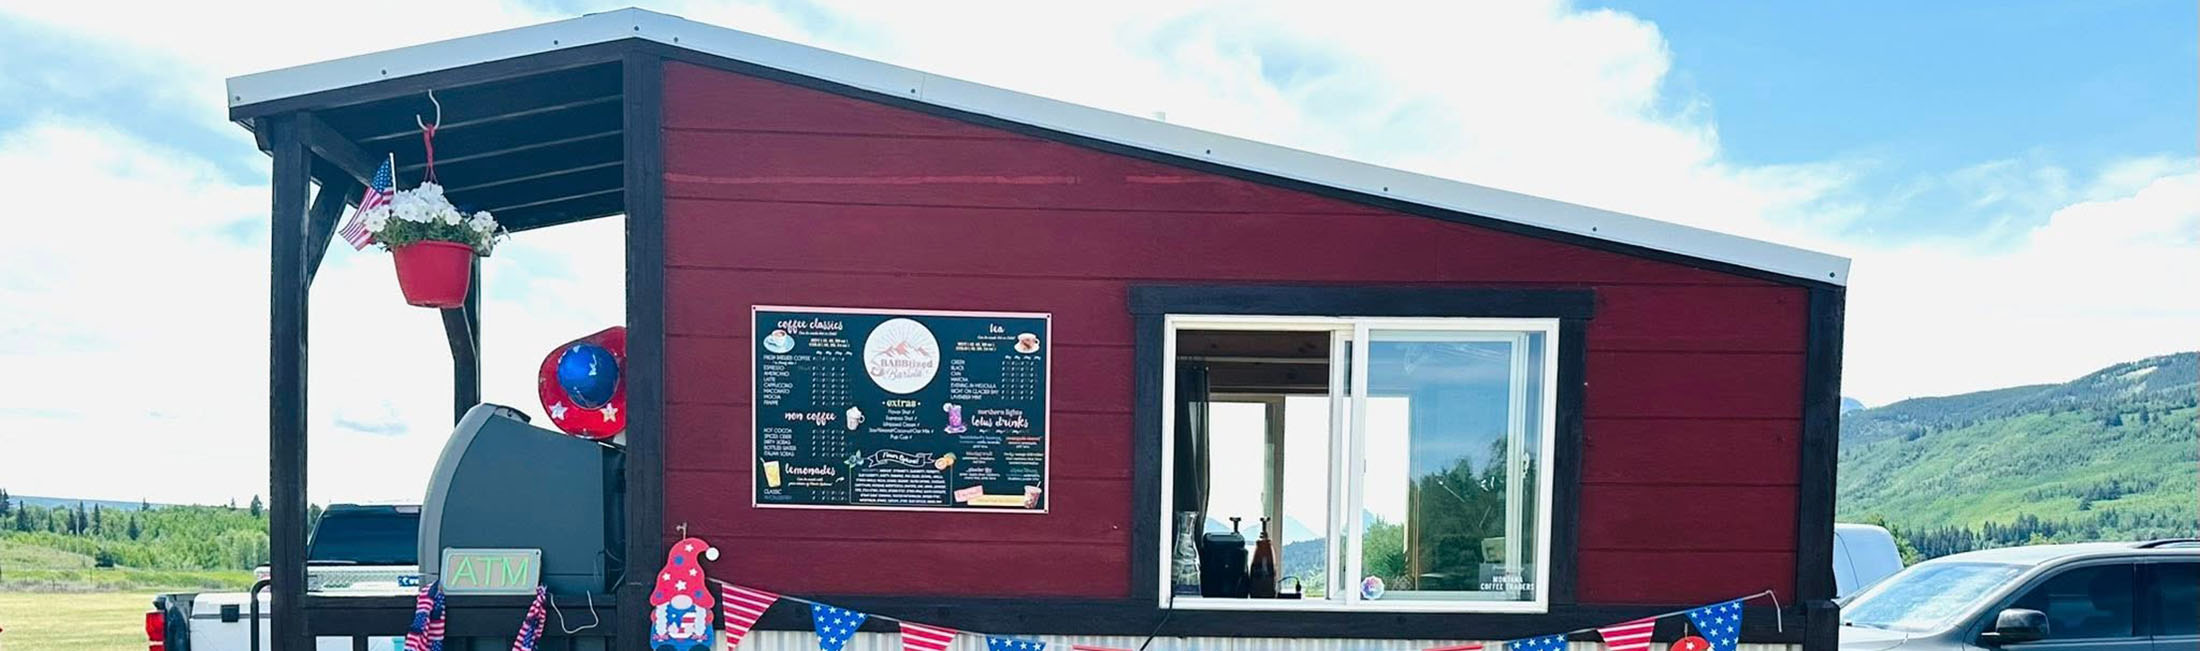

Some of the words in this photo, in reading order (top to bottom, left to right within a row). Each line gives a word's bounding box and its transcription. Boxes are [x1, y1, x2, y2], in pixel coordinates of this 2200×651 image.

[777, 319, 808, 334] coffee
[809, 318, 843, 331] classics
[989, 323, 1006, 334] tea
[784, 412, 803, 421] non
[806, 412, 836, 427] coffee
[971, 415, 993, 427] lotus
[995, 416, 1029, 428] drinks
[785, 463, 836, 476] lemonades
[451, 556, 529, 586] ATM
[1492, 575, 1524, 583] MONTANA
[1480, 583, 1504, 591] COFFEE
